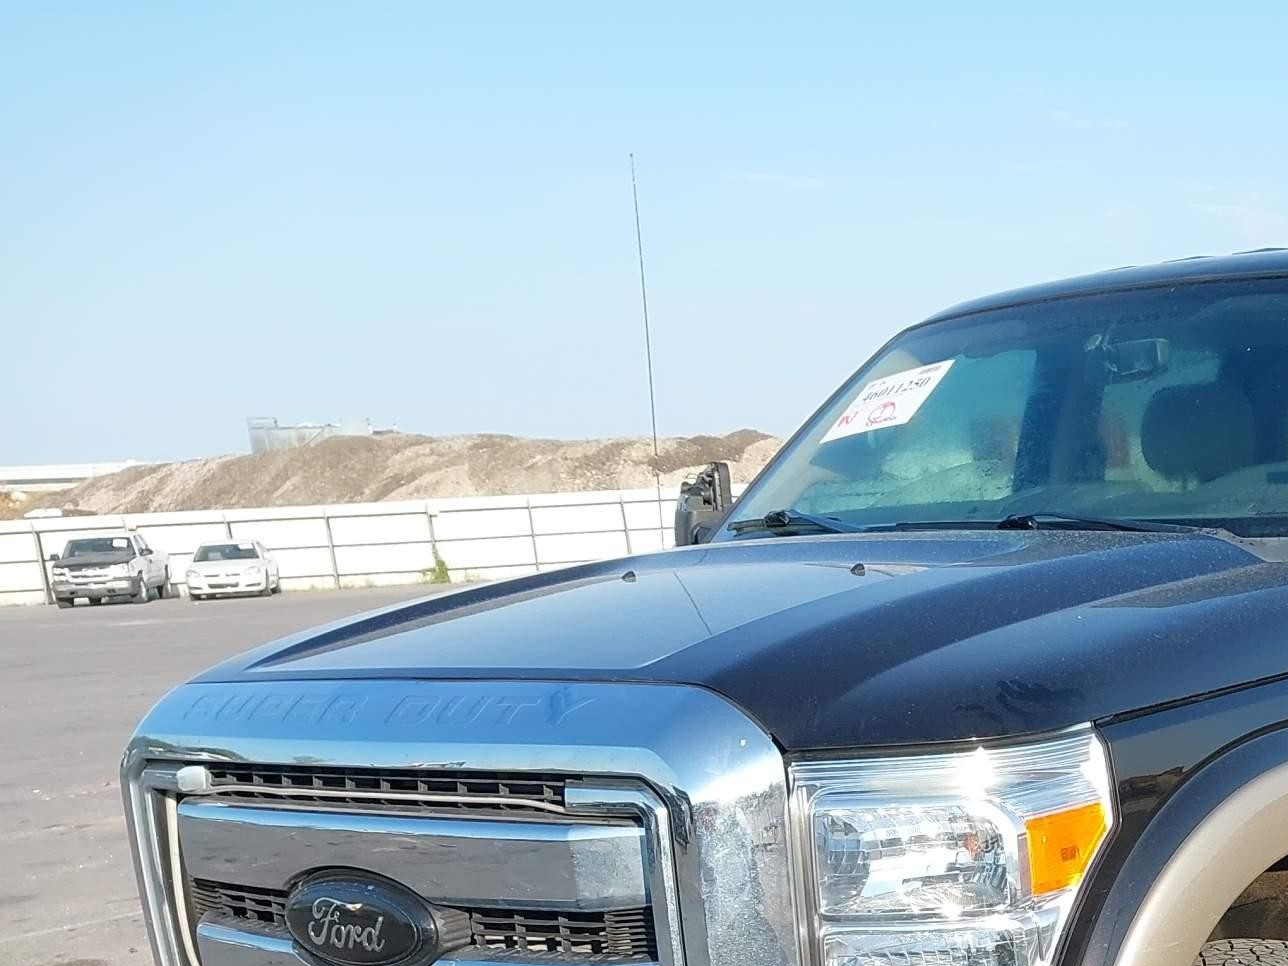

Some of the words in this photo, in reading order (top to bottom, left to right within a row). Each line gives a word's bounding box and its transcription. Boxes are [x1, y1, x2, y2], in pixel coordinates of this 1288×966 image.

[182, 693, 368, 723] SUPER
[384, 694, 596, 728] DUTY
[308, 896, 385, 952] Ford
